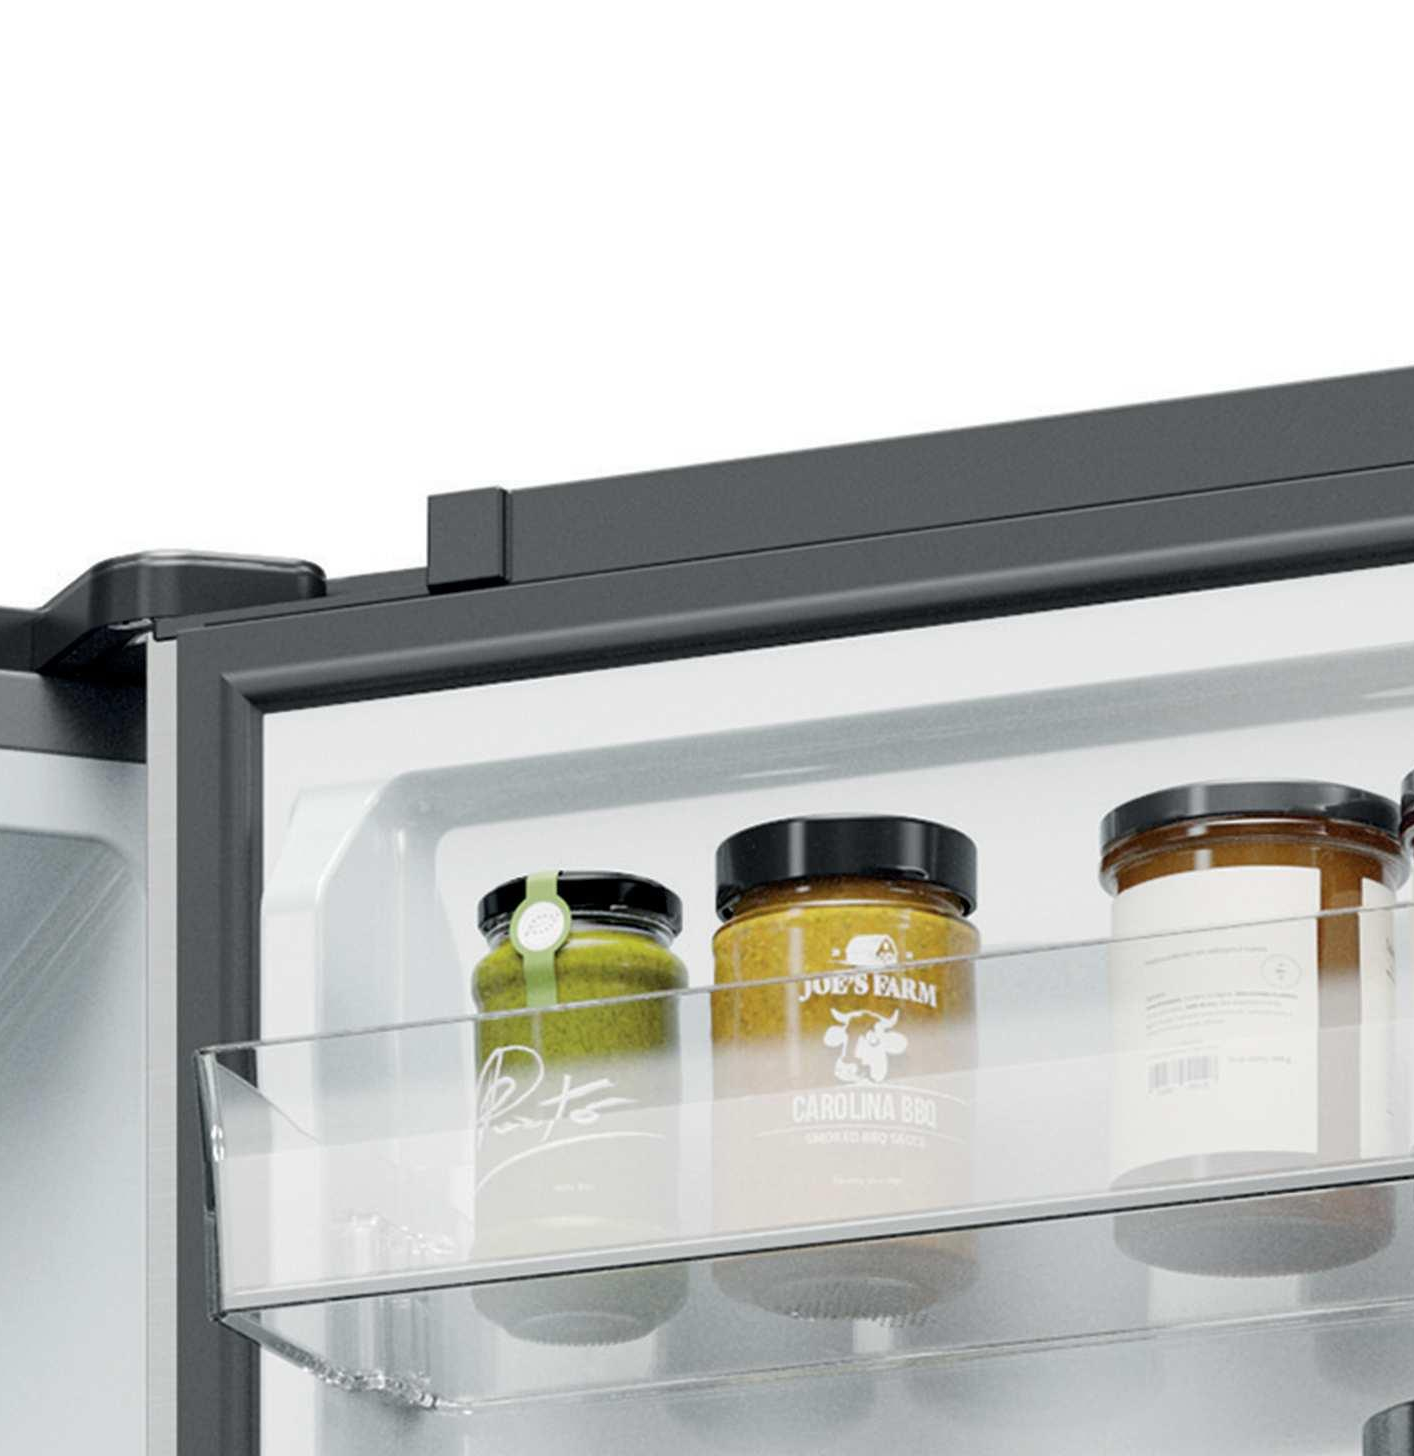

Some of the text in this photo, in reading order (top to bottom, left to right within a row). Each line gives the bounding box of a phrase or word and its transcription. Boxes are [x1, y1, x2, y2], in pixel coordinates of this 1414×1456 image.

[798, 973, 938, 1008] JOE'S FARM
[791, 1091, 937, 1128] CAROLINA BBQ
